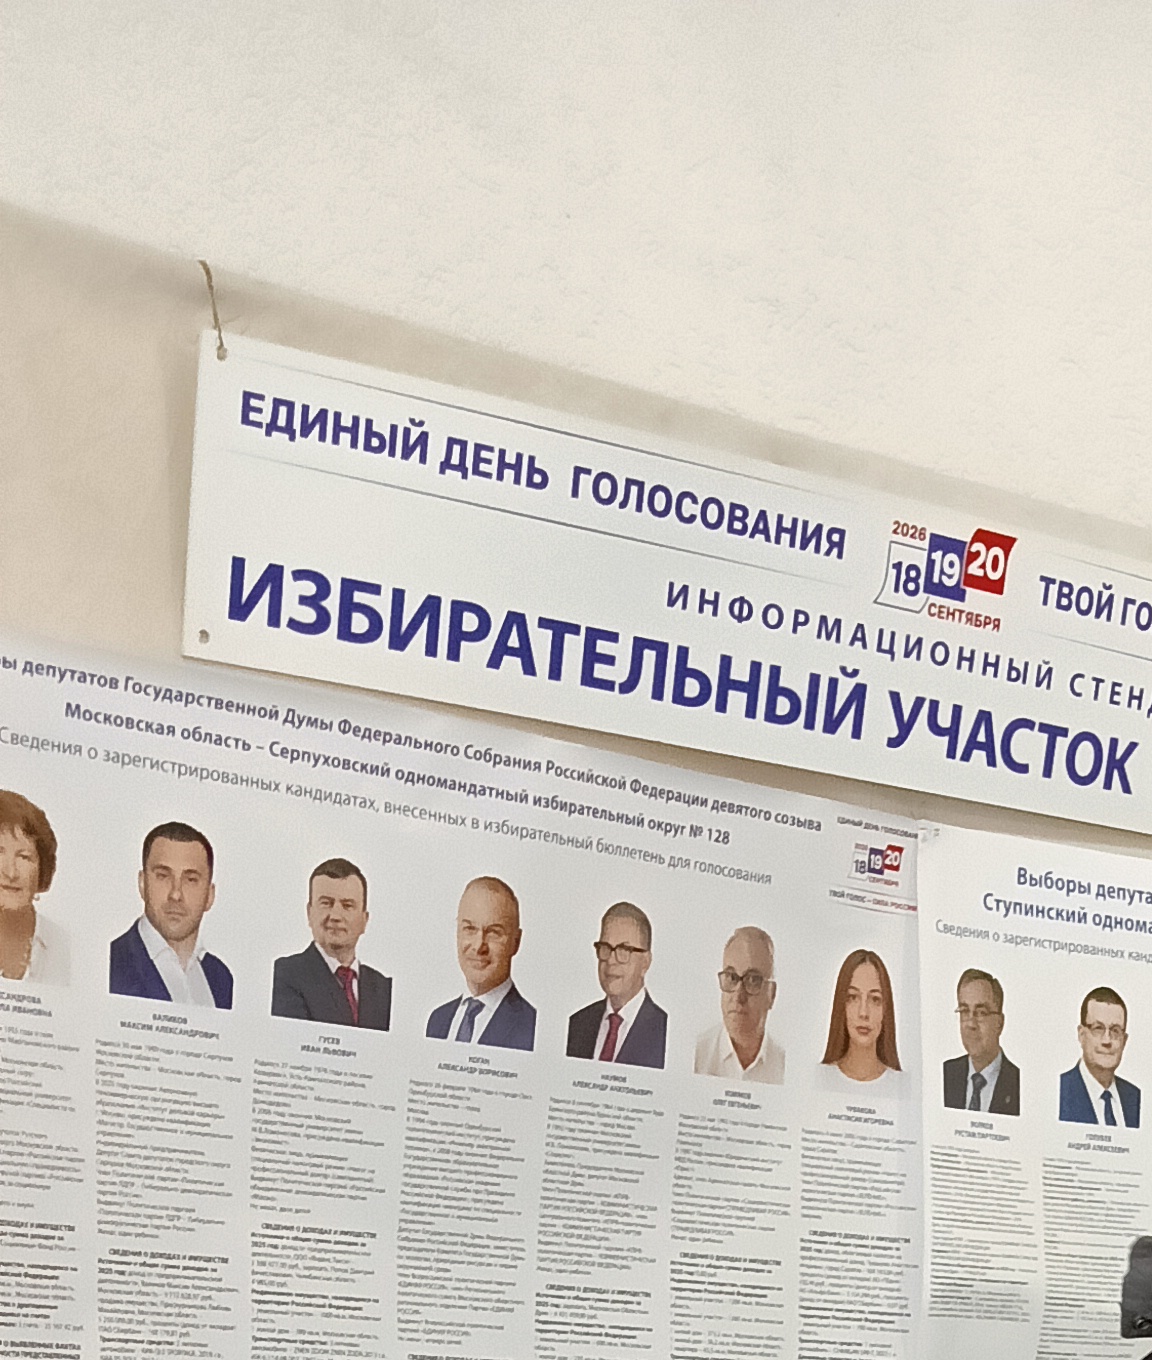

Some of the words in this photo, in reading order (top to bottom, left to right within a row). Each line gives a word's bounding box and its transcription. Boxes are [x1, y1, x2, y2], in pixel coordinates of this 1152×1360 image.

[240, 390, 427, 466] ЕДИНЫЙ
[439, 435, 550, 491] ДЕНЬ
[570, 465, 847, 561] ГОЛОСОВАНИЯ
[892, 520, 927, 542] 2026
[891, 560, 921, 597] 18
[931, 549, 960, 587] 19
[966, 542, 1005, 582] 20
[927, 602, 1002, 633] СЕНТЯБРЯ
[1038, 575, 1114, 622] ТВОЙ
[666, 581, 1054, 691] ИНФОРМАЦИОННЫЙ
[226, 556, 868, 741] ИЗБИРАТЕЛЬНЫЙ
[885, 690, 1140, 795] УЧАСТОК
[22, 659, 119, 690] депутатов
[123, 675, 279, 721] Государственной
[283, 707, 333, 732] Думы
[338, 714, 460, 757] Федерального
[463, 744, 542, 772] Собрания
[545, 760, 627, 791] Российской
[630, 778, 708, 808] Федерации
[711, 798, 772, 821] девятого
[774, 811, 822, 832] созыва
[64, 703, 175, 737] Московская
[181, 726, 251, 752] область
[269, 741, 391, 778] Серпуховский
[394, 769, 529, 804] одномандатный
[532, 791, 645, 829] избирательный
[647, 818, 685, 838] округ
[689, 822, 703, 838] №
[707, 827, 731, 845] 128
[0, 726, 82, 757] Сведения
[87, 748, 98, 759] о
[102, 749, 281, 793] зарегистрированных
[285, 783, 380, 813] кандидатах,
[383, 800, 467, 828] внесенных
[471, 817, 479, 829] в
[483, 818, 593, 852] избирательный
[596, 838, 665, 865] бюллетень
[668, 855, 690, 870] для
[694, 860, 772, 885] голосования
[854, 859, 866, 874] 18
[870, 854, 882, 870] 19
[884, 850, 899, 866] 20
[1017, 867, 1092, 896] Выборы
[983, 892, 1088, 925] Ступинский
[935, 919, 990, 940] Сведения
[992, 932, 999, 942] о
[1002, 934, 1125, 960] зарегистрированных
